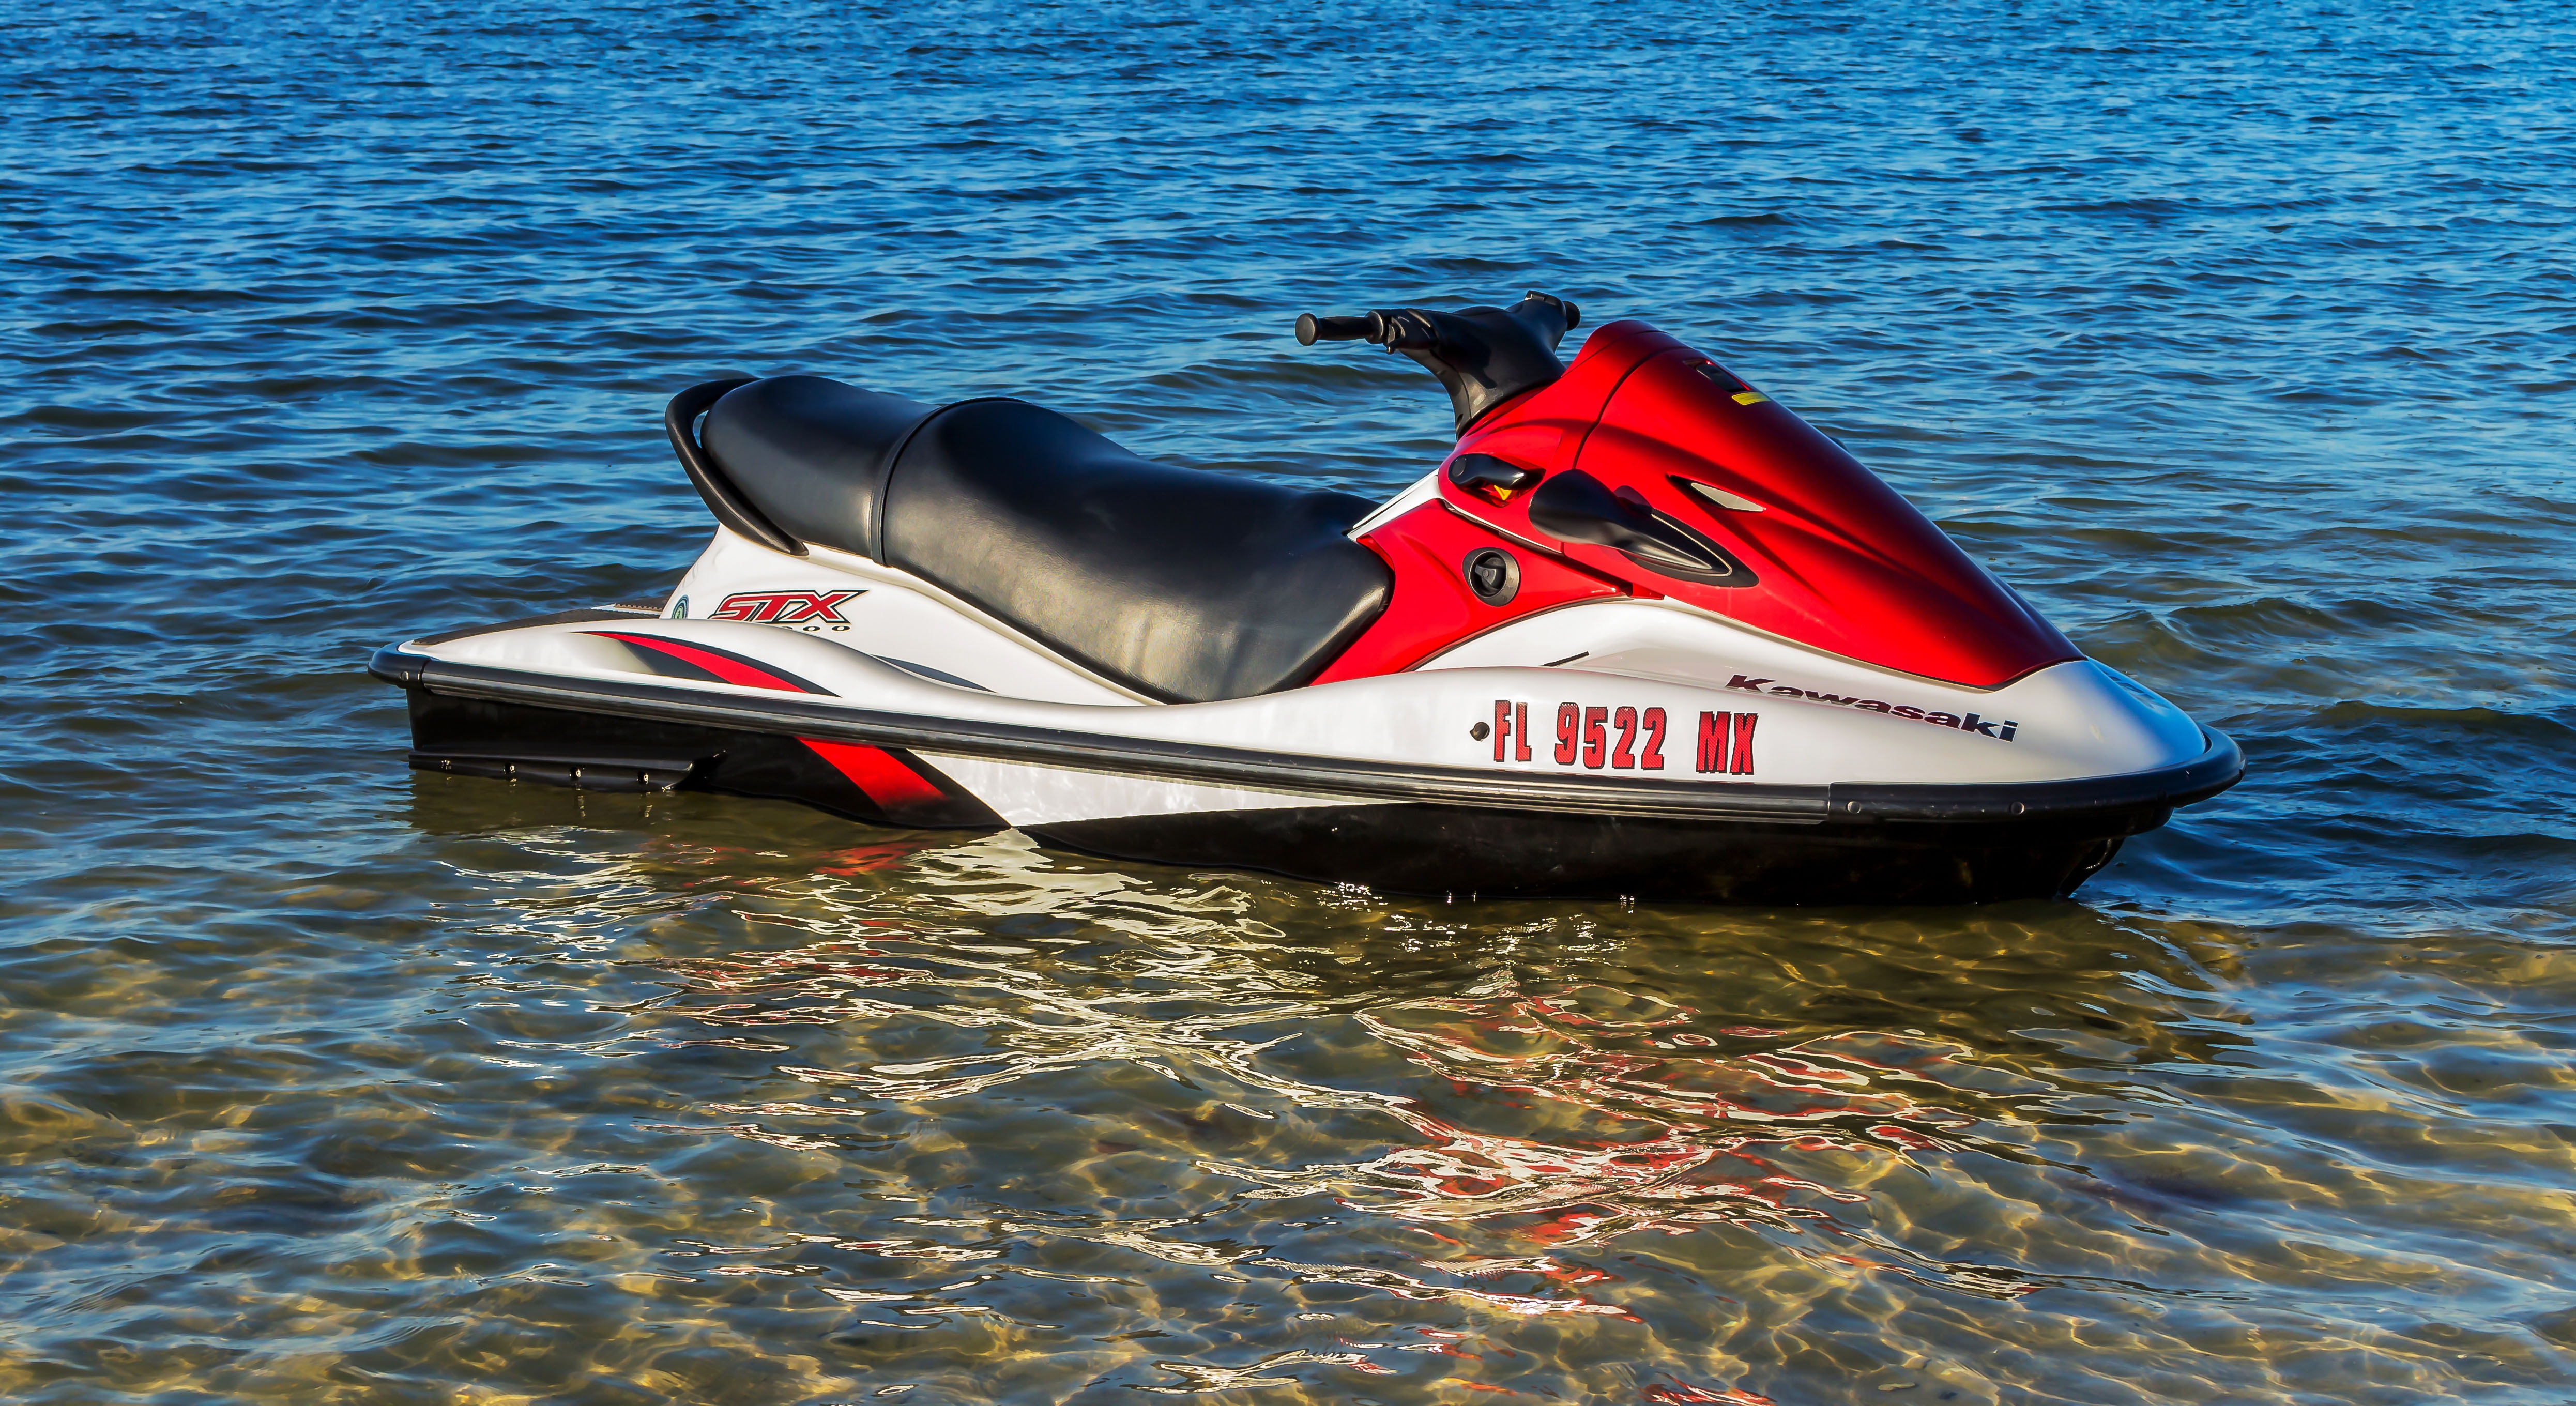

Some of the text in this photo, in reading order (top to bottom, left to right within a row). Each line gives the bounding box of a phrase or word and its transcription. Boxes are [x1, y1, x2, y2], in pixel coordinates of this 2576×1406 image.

[707, 589, 869, 624] STX
[1493, 700, 1759, 775] FL 9522 MX
[1725, 674, 2018, 743] Kawasaki
